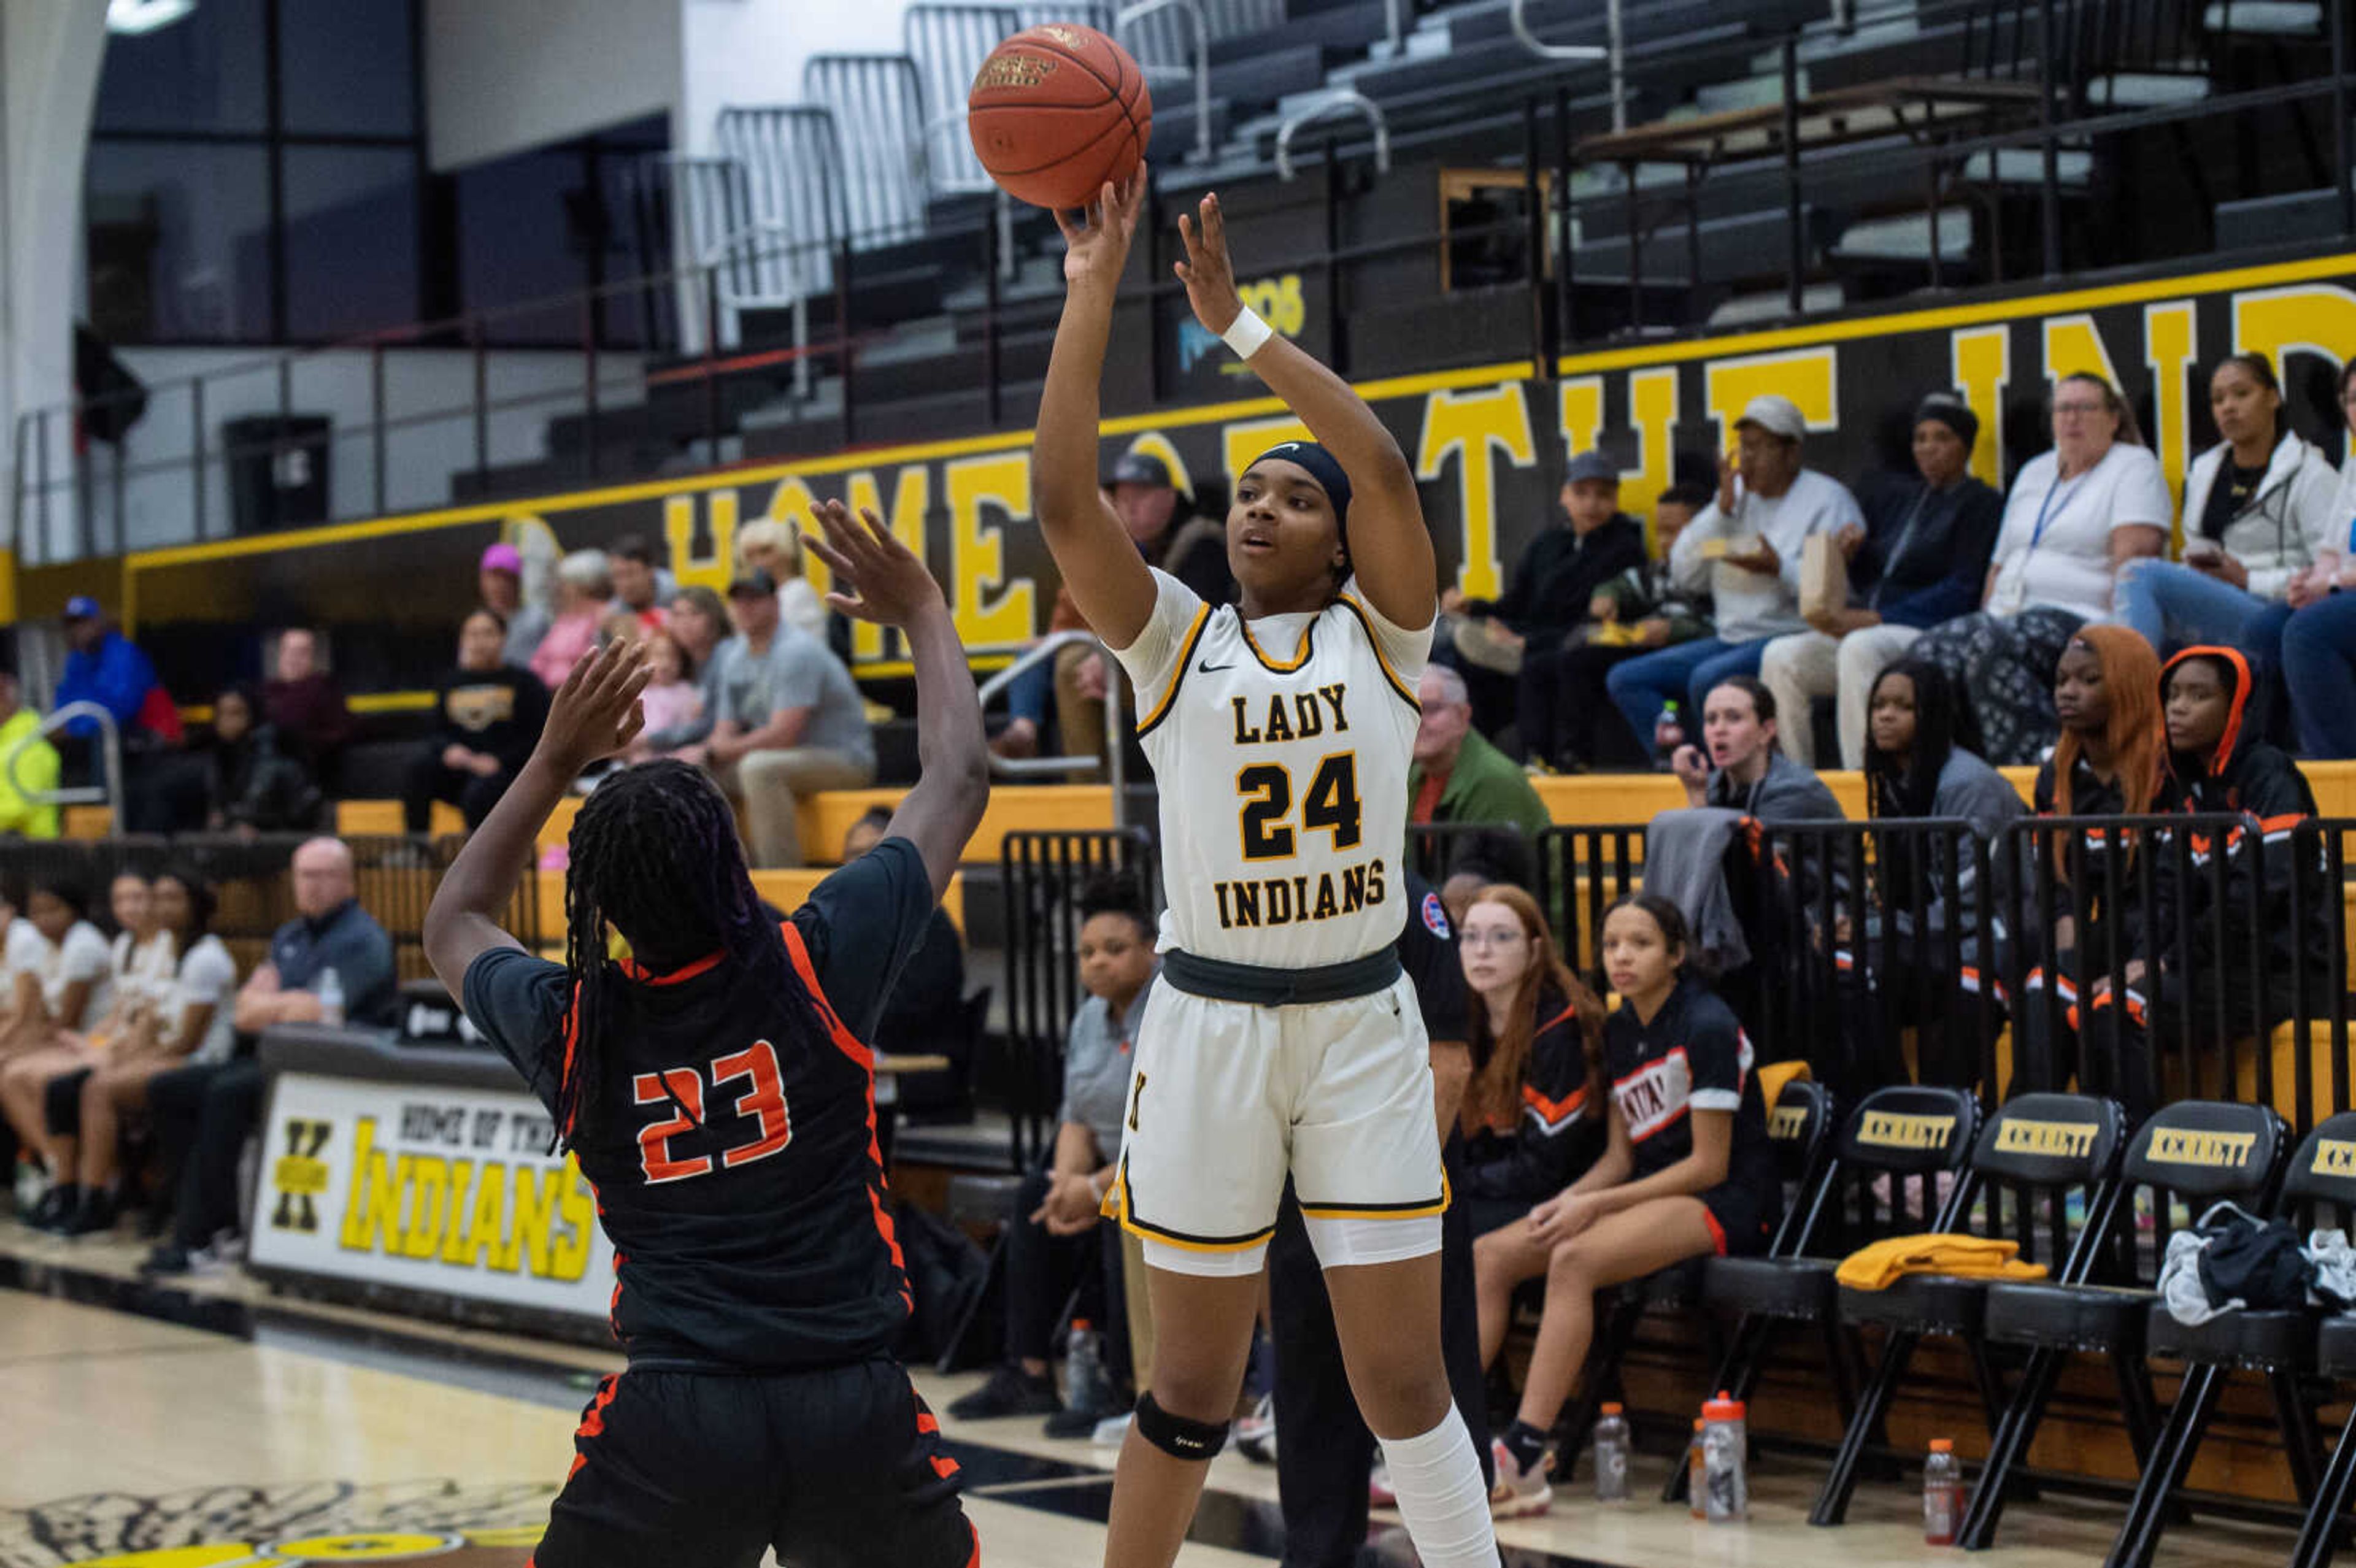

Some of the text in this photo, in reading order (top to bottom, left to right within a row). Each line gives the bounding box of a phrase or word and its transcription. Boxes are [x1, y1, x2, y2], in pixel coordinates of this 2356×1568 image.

[664, 450, 1036, 661] HOME
[1232, 683, 1349, 744] LADY
[1236, 750, 1362, 863] 24
[1214, 858, 1385, 929] INDIANS
[401, 1105, 464, 1146] HOME
[472, 1109, 502, 1148] OF
[633, 1039, 792, 1185] 23
